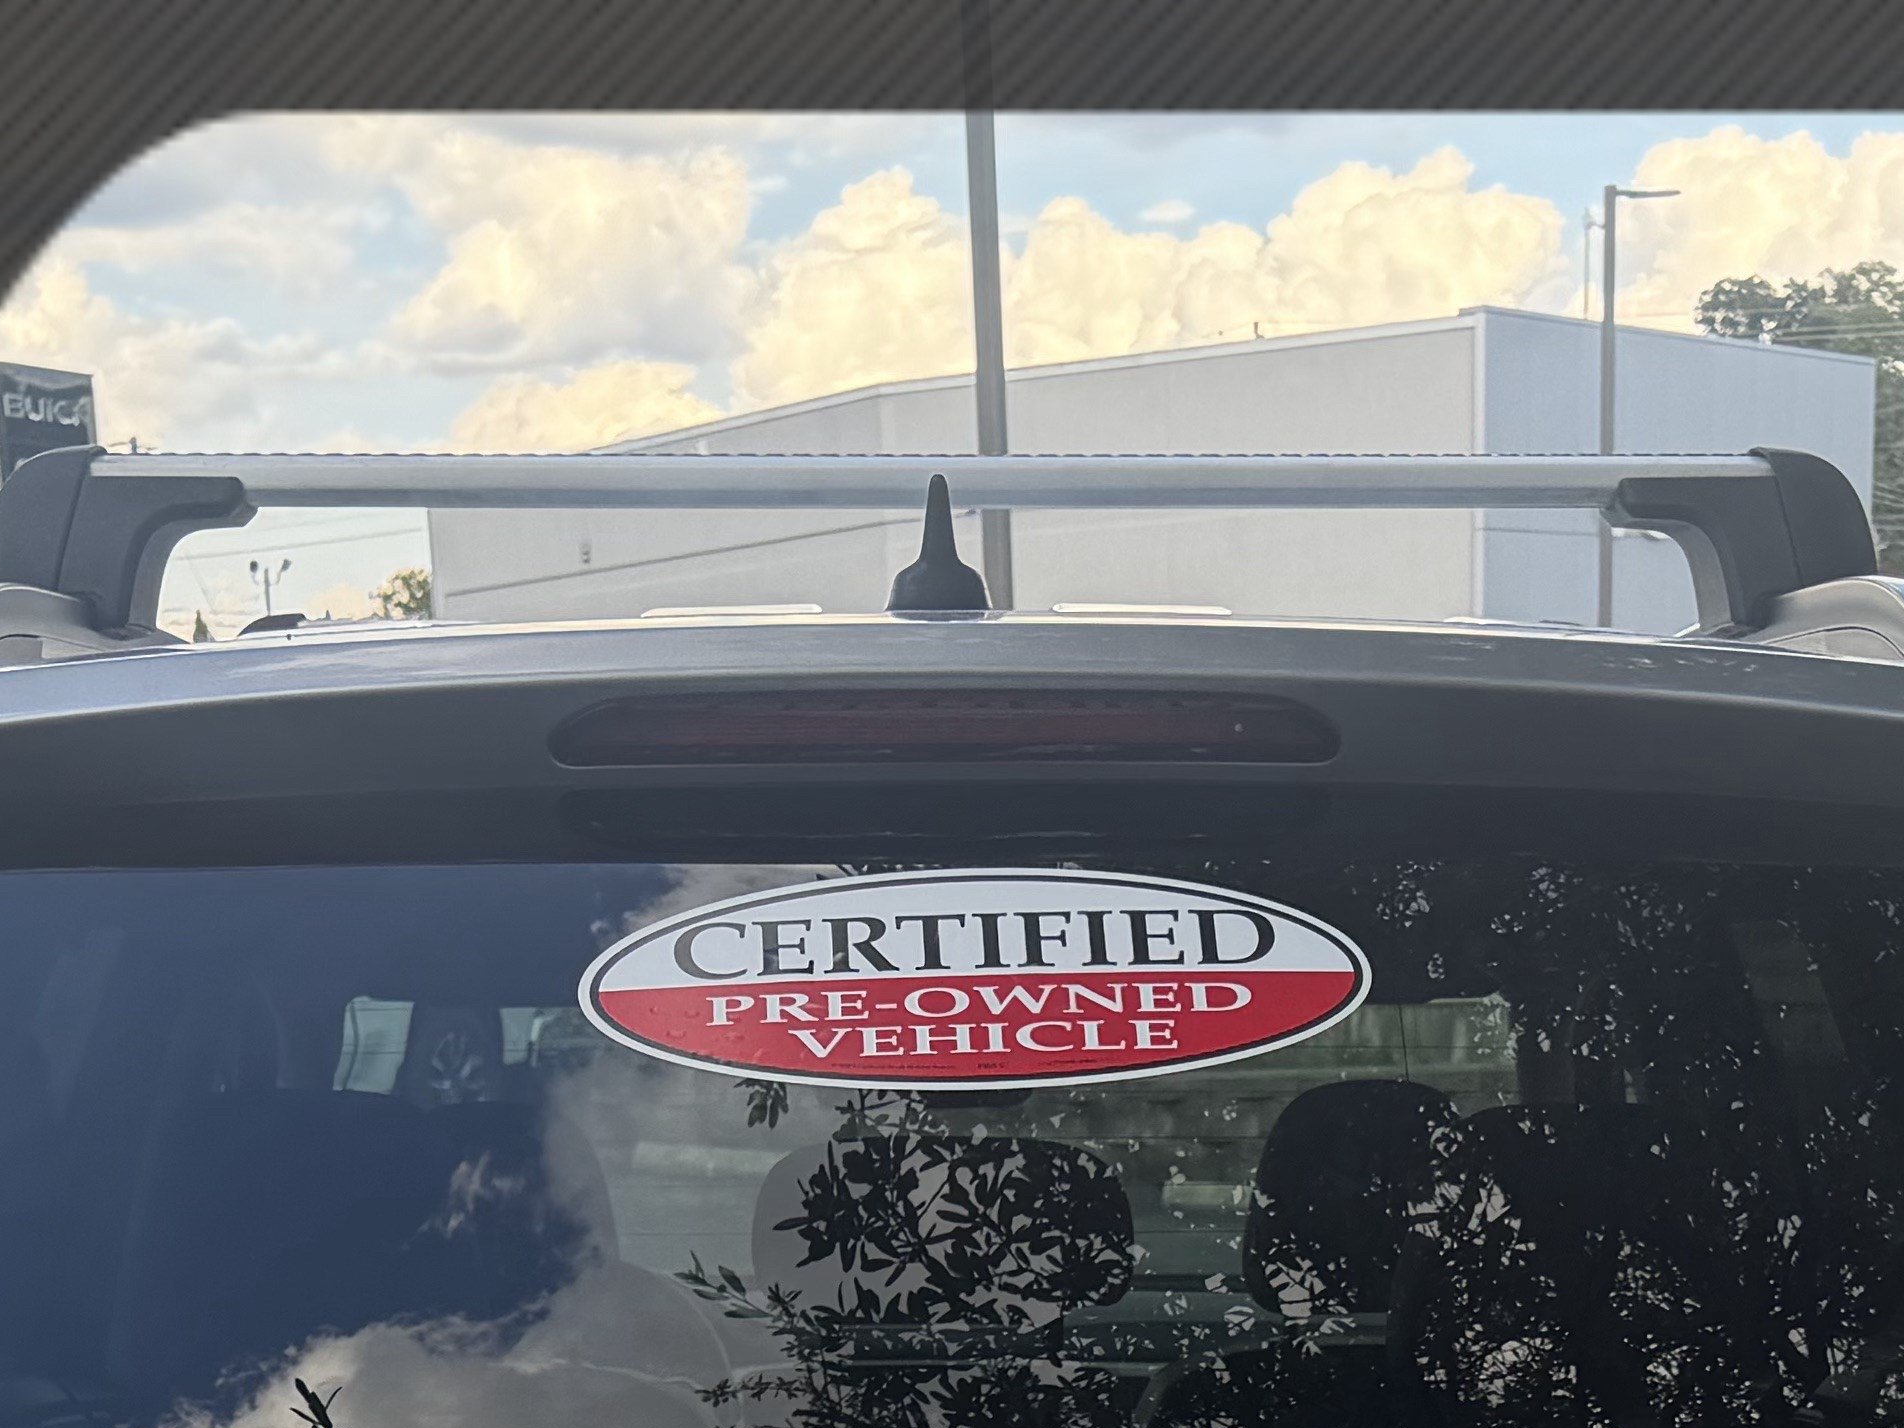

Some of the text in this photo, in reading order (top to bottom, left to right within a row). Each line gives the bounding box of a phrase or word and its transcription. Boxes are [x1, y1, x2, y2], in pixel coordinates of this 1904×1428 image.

[672, 908, 1277, 979] CERTIFIED
[706, 982, 1253, 1027] PRE-OWNED
[789, 1018, 1180, 1059] VEHICLE
